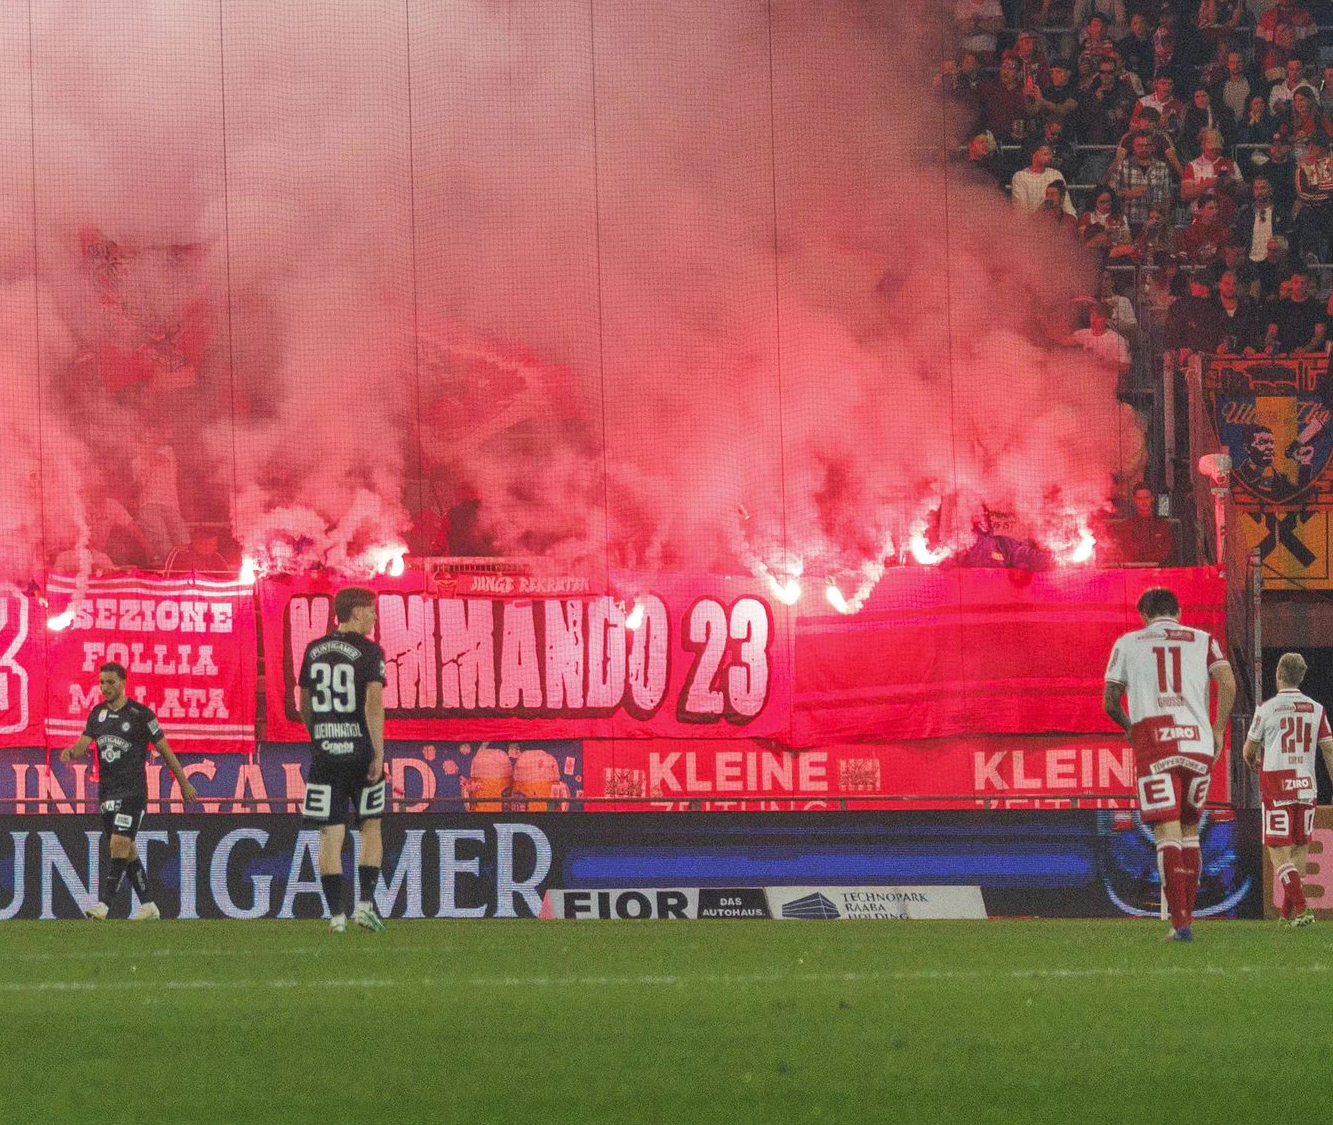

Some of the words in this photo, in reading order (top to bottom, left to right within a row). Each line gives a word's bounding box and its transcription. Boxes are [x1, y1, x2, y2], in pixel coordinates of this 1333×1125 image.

[72, 598, 233, 633] SEZIONE
[83, 642, 219, 675] FOLLIA
[287, 592, 671, 714] KMMANDO
[679, 595, 775, 727] 23
[1152, 646, 1182, 693] 11
[68, 683, 230, 719] MLATA
[310, 662, 358, 713] 39
[1159, 727, 1195, 742] ZIRO
[1279, 716, 1313, 753] 24
[648, 751, 829, 793] KLEINE
[973, 748, 1137, 792] KLEIN
[1285, 779, 1309, 790] ZIRO
[563, 890, 689, 920] FIOR
[720, 897, 743, 907] DAS
[841, 892, 929, 903] TECHNOPARK
[844, 902, 887, 913] RAABA
